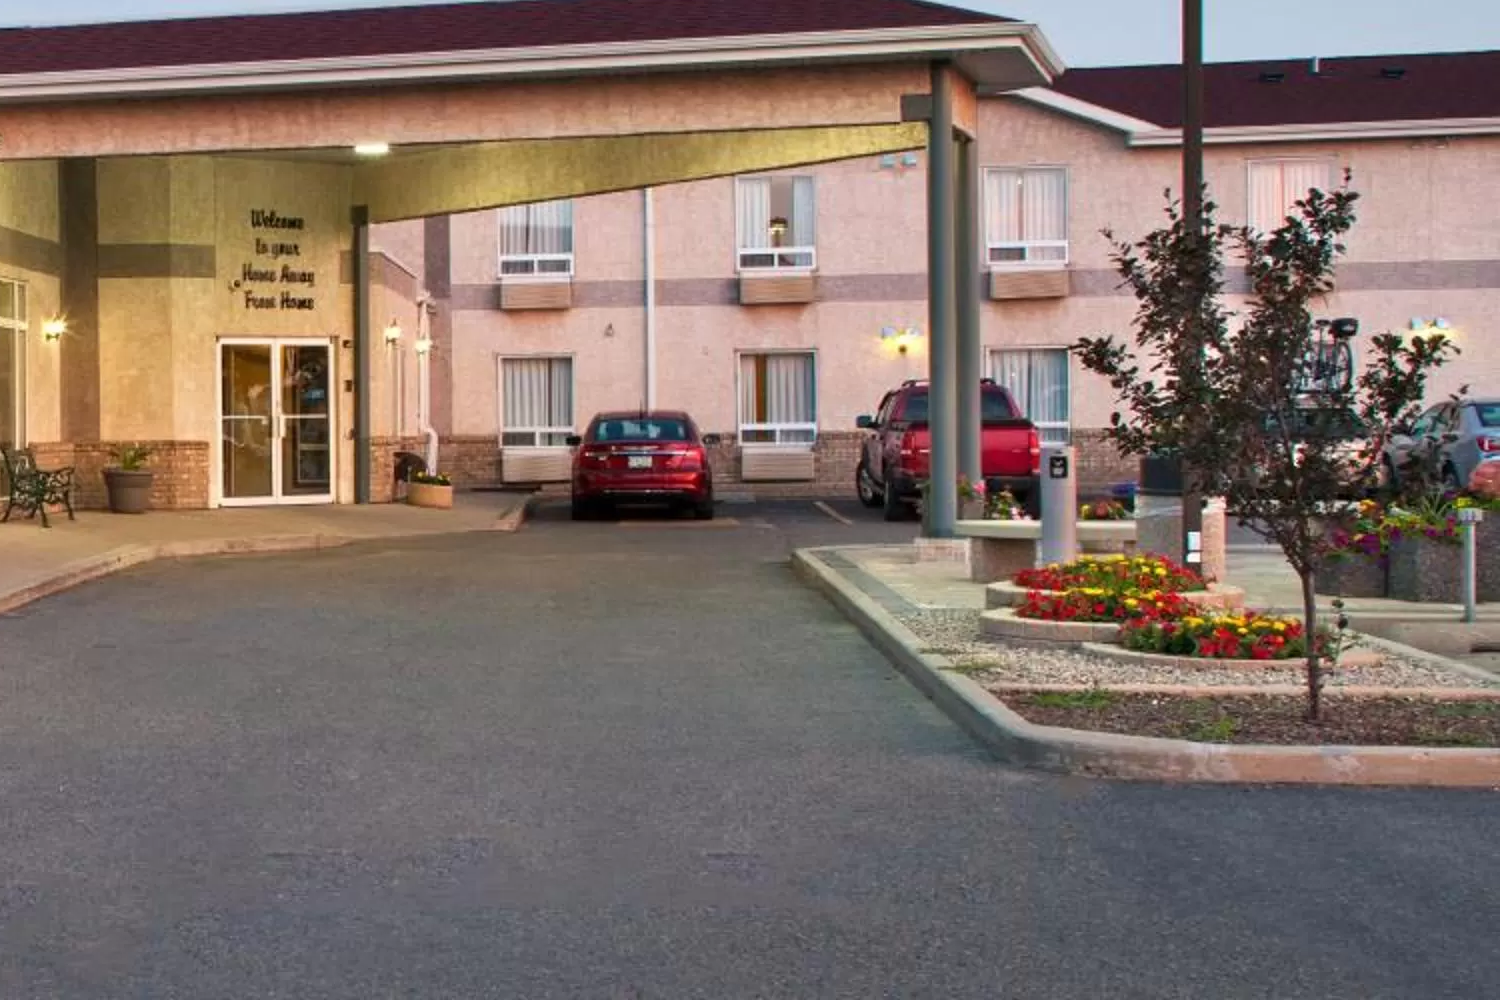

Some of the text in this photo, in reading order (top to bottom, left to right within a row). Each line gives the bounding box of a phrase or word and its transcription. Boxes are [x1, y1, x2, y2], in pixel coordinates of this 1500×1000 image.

[251, 209, 304, 230] Welcome
[242, 262, 315, 288] Home Away
[244, 290, 315, 310] From Home
